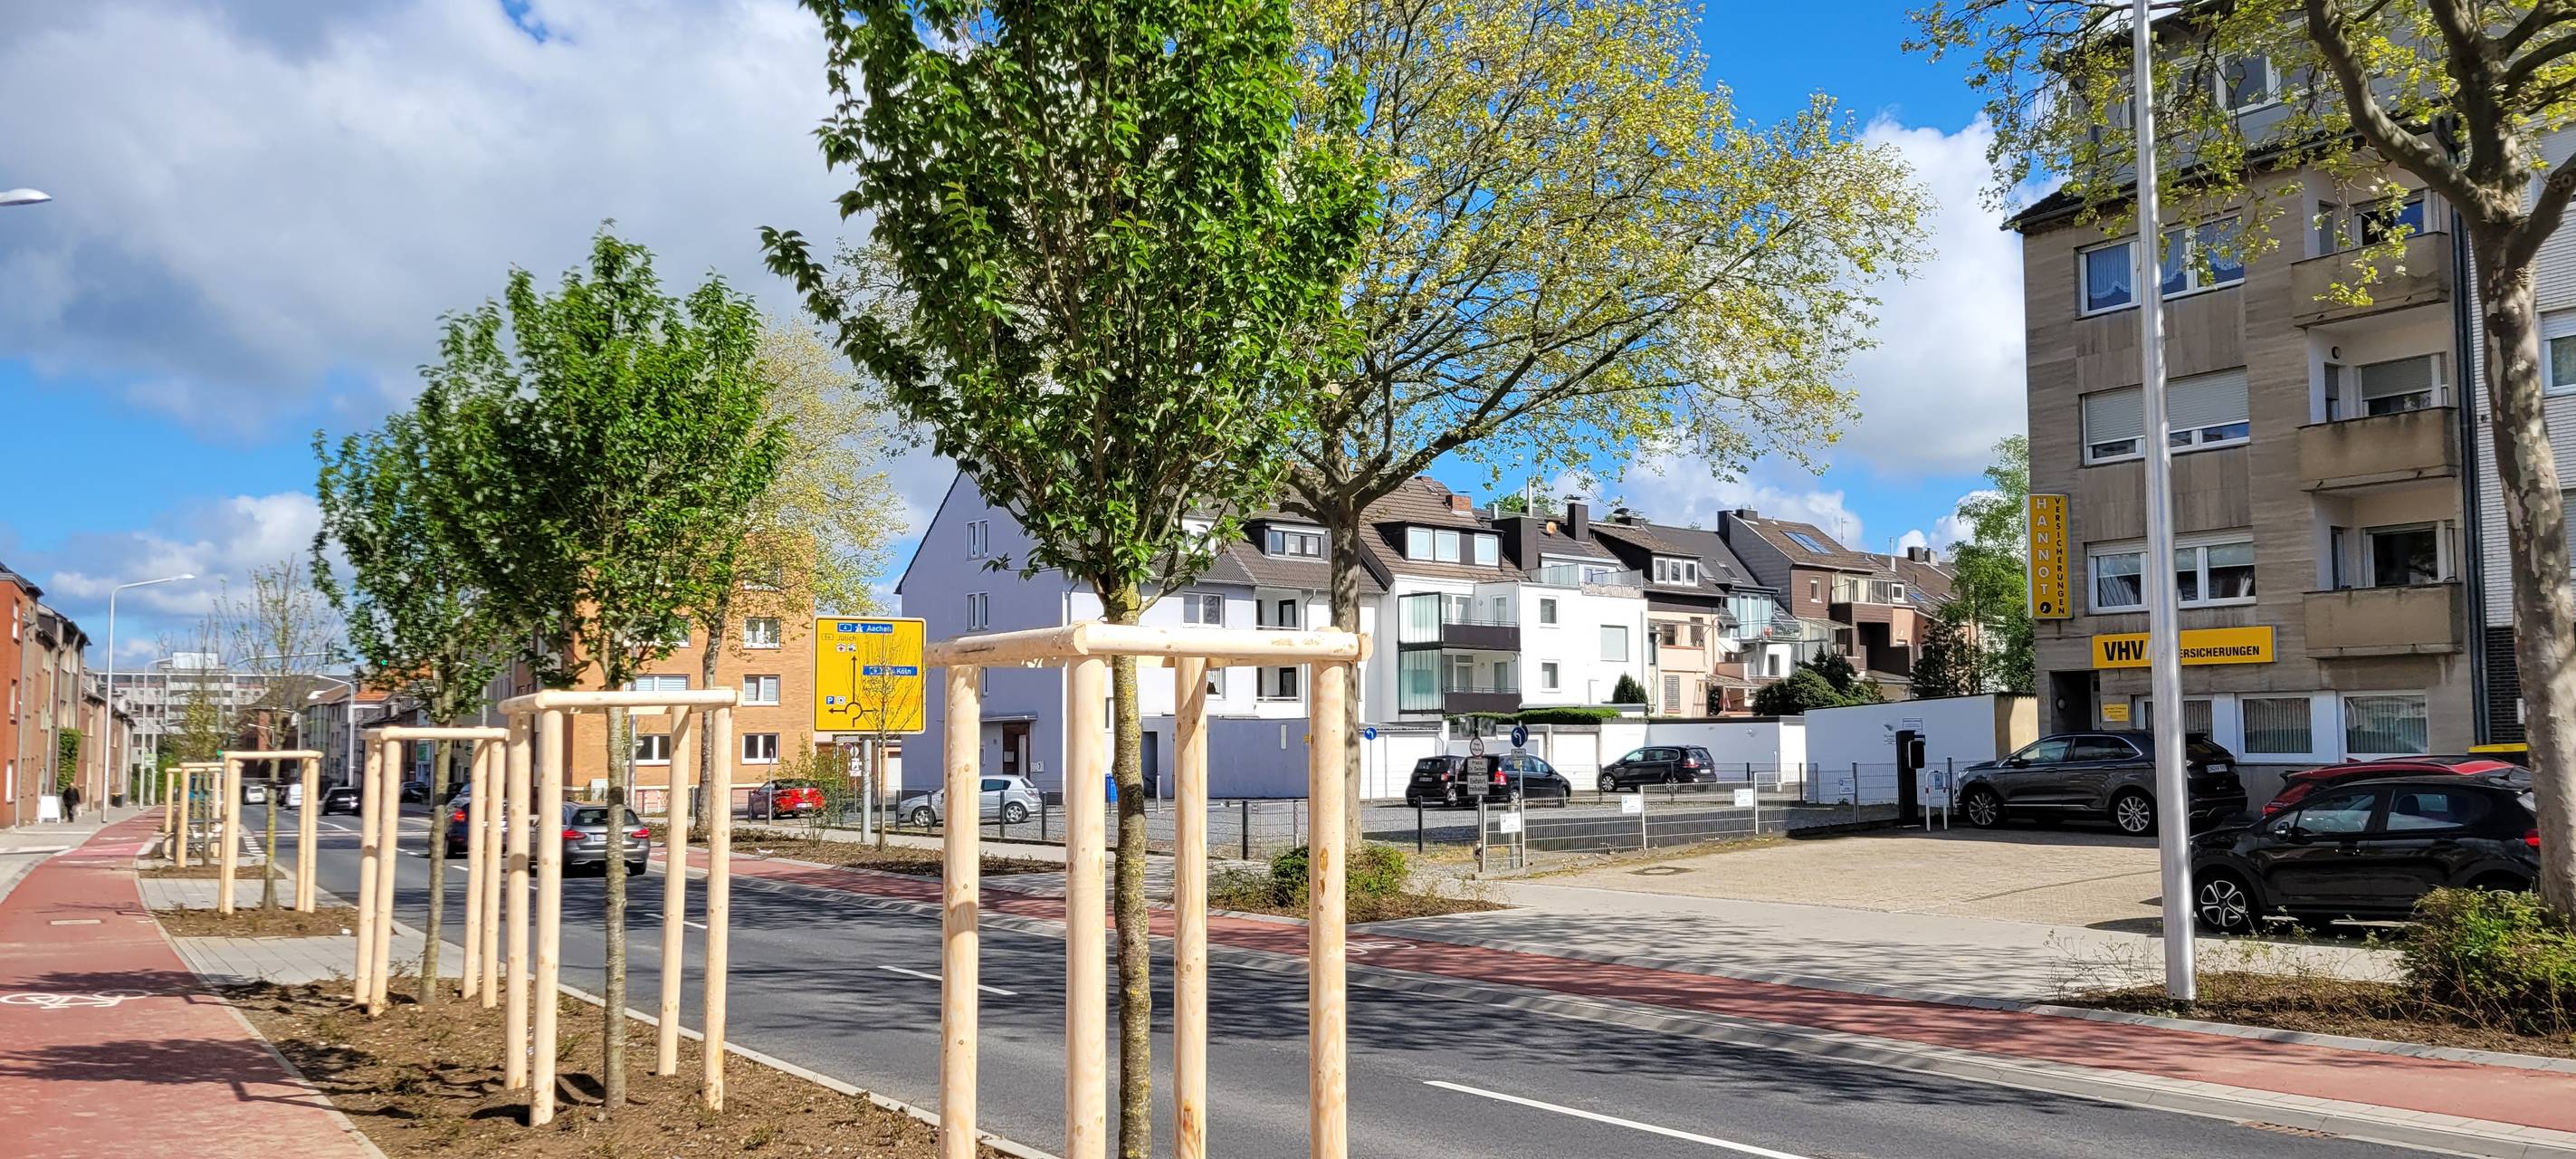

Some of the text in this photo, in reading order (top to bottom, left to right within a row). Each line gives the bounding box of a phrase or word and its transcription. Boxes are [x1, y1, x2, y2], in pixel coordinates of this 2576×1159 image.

[2036, 498, 2049, 595] HANNOT
[2055, 497, 2065, 614] VERSICHERUNGEN
[866, 624, 892, 632] Aachen
[2104, 639, 2260, 661] VHV ERSICHERUNGEN
